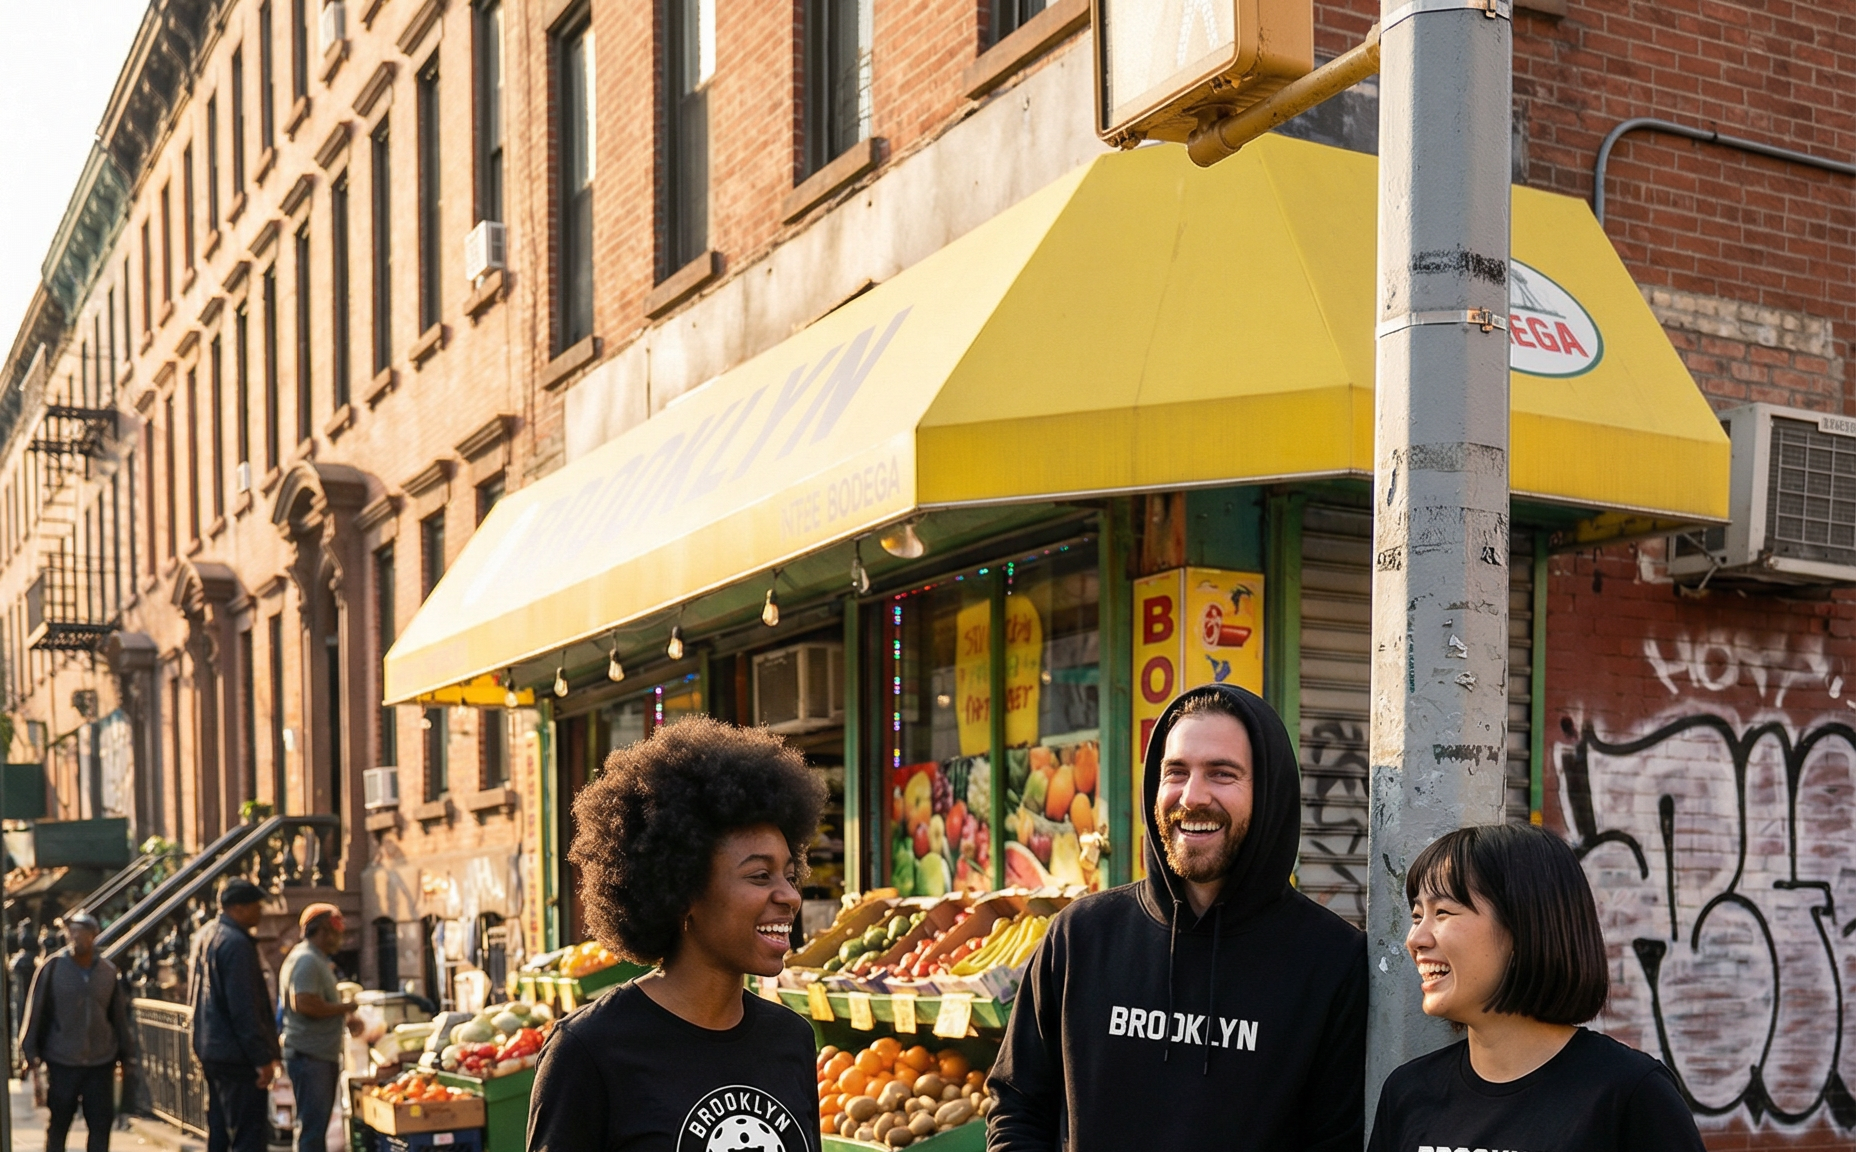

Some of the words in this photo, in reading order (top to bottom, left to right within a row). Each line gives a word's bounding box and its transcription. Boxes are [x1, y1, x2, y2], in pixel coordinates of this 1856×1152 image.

[1510, 314, 1589, 358] EGA
[828, 454, 901, 524] BODEGA
[1108, 1005, 1259, 1052] BROOKLYN
[688, 1091, 792, 1140] BROOKLYN
